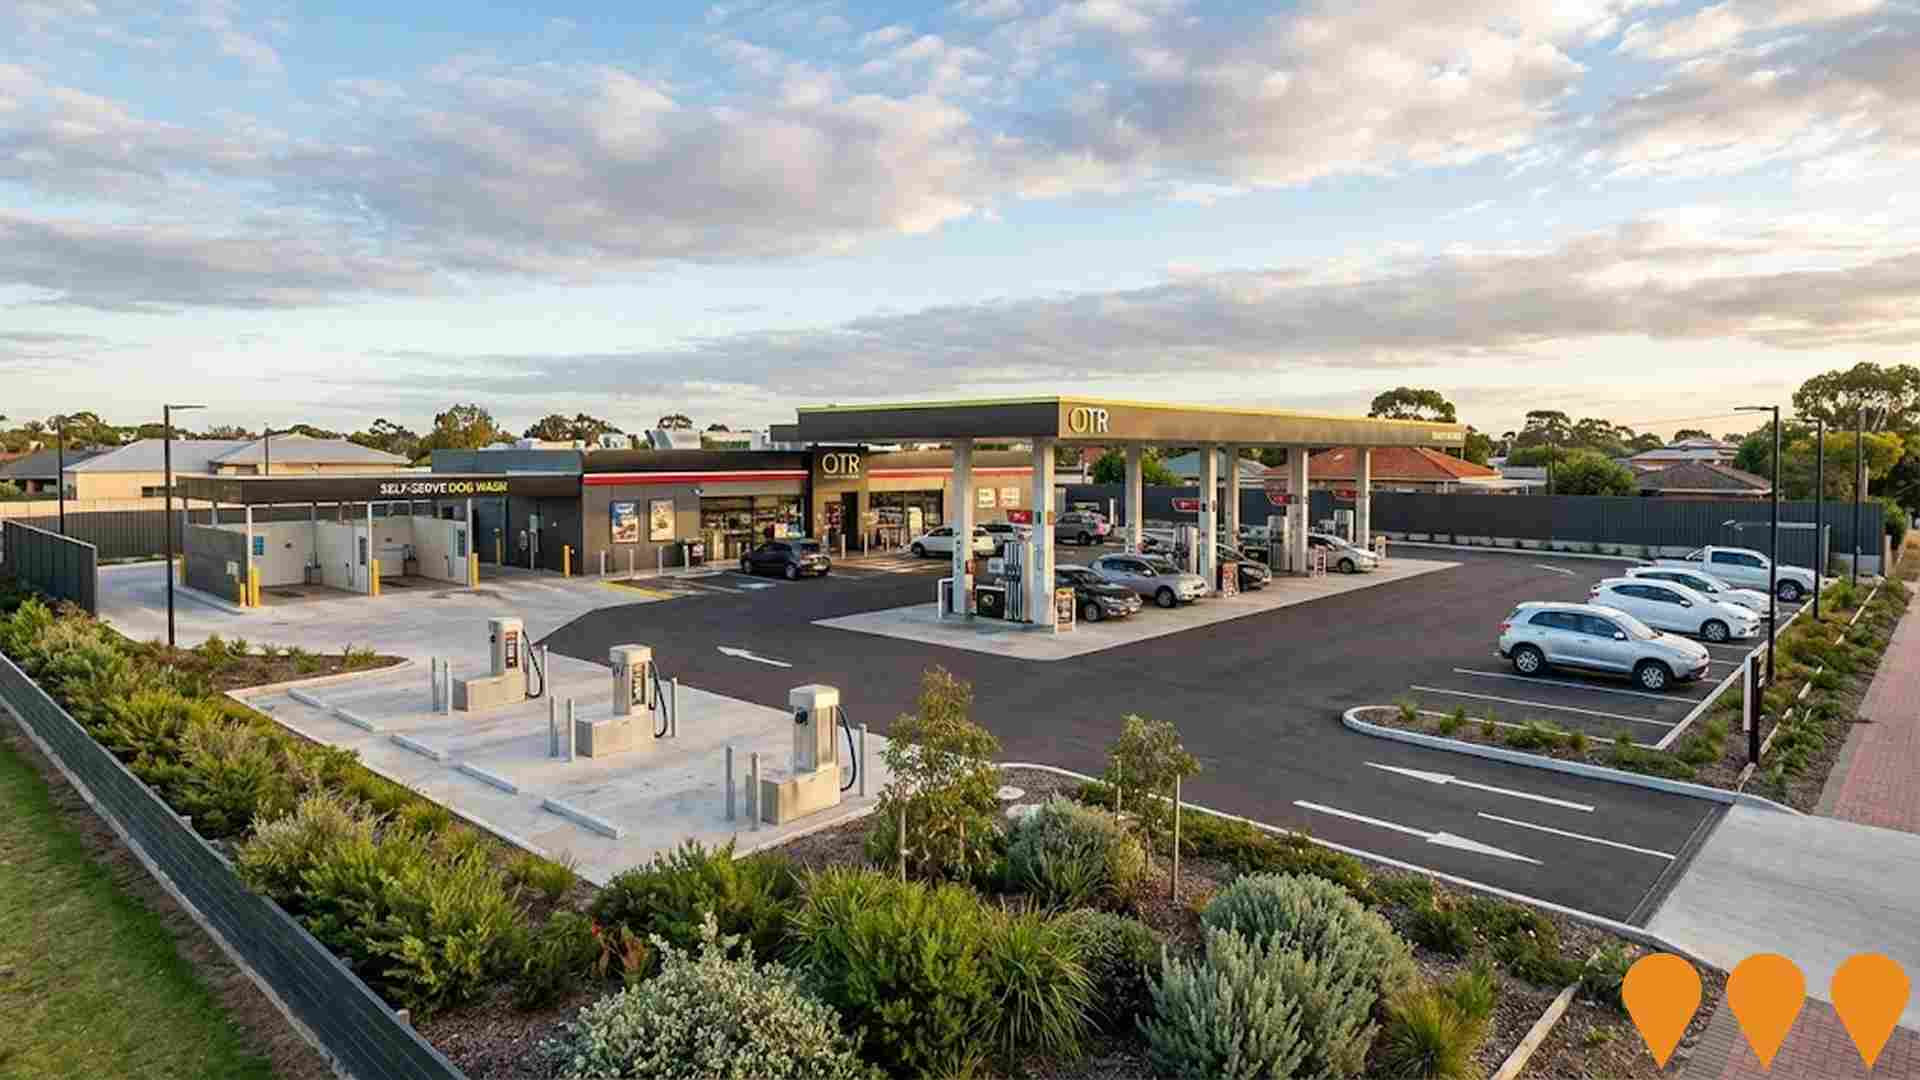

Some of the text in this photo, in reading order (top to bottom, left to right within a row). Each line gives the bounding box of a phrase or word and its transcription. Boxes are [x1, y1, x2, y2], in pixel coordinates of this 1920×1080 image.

[1068, 407, 1109, 433] OTR
[822, 453, 860, 474] OTR
[448, 482, 474, 494] DOG
